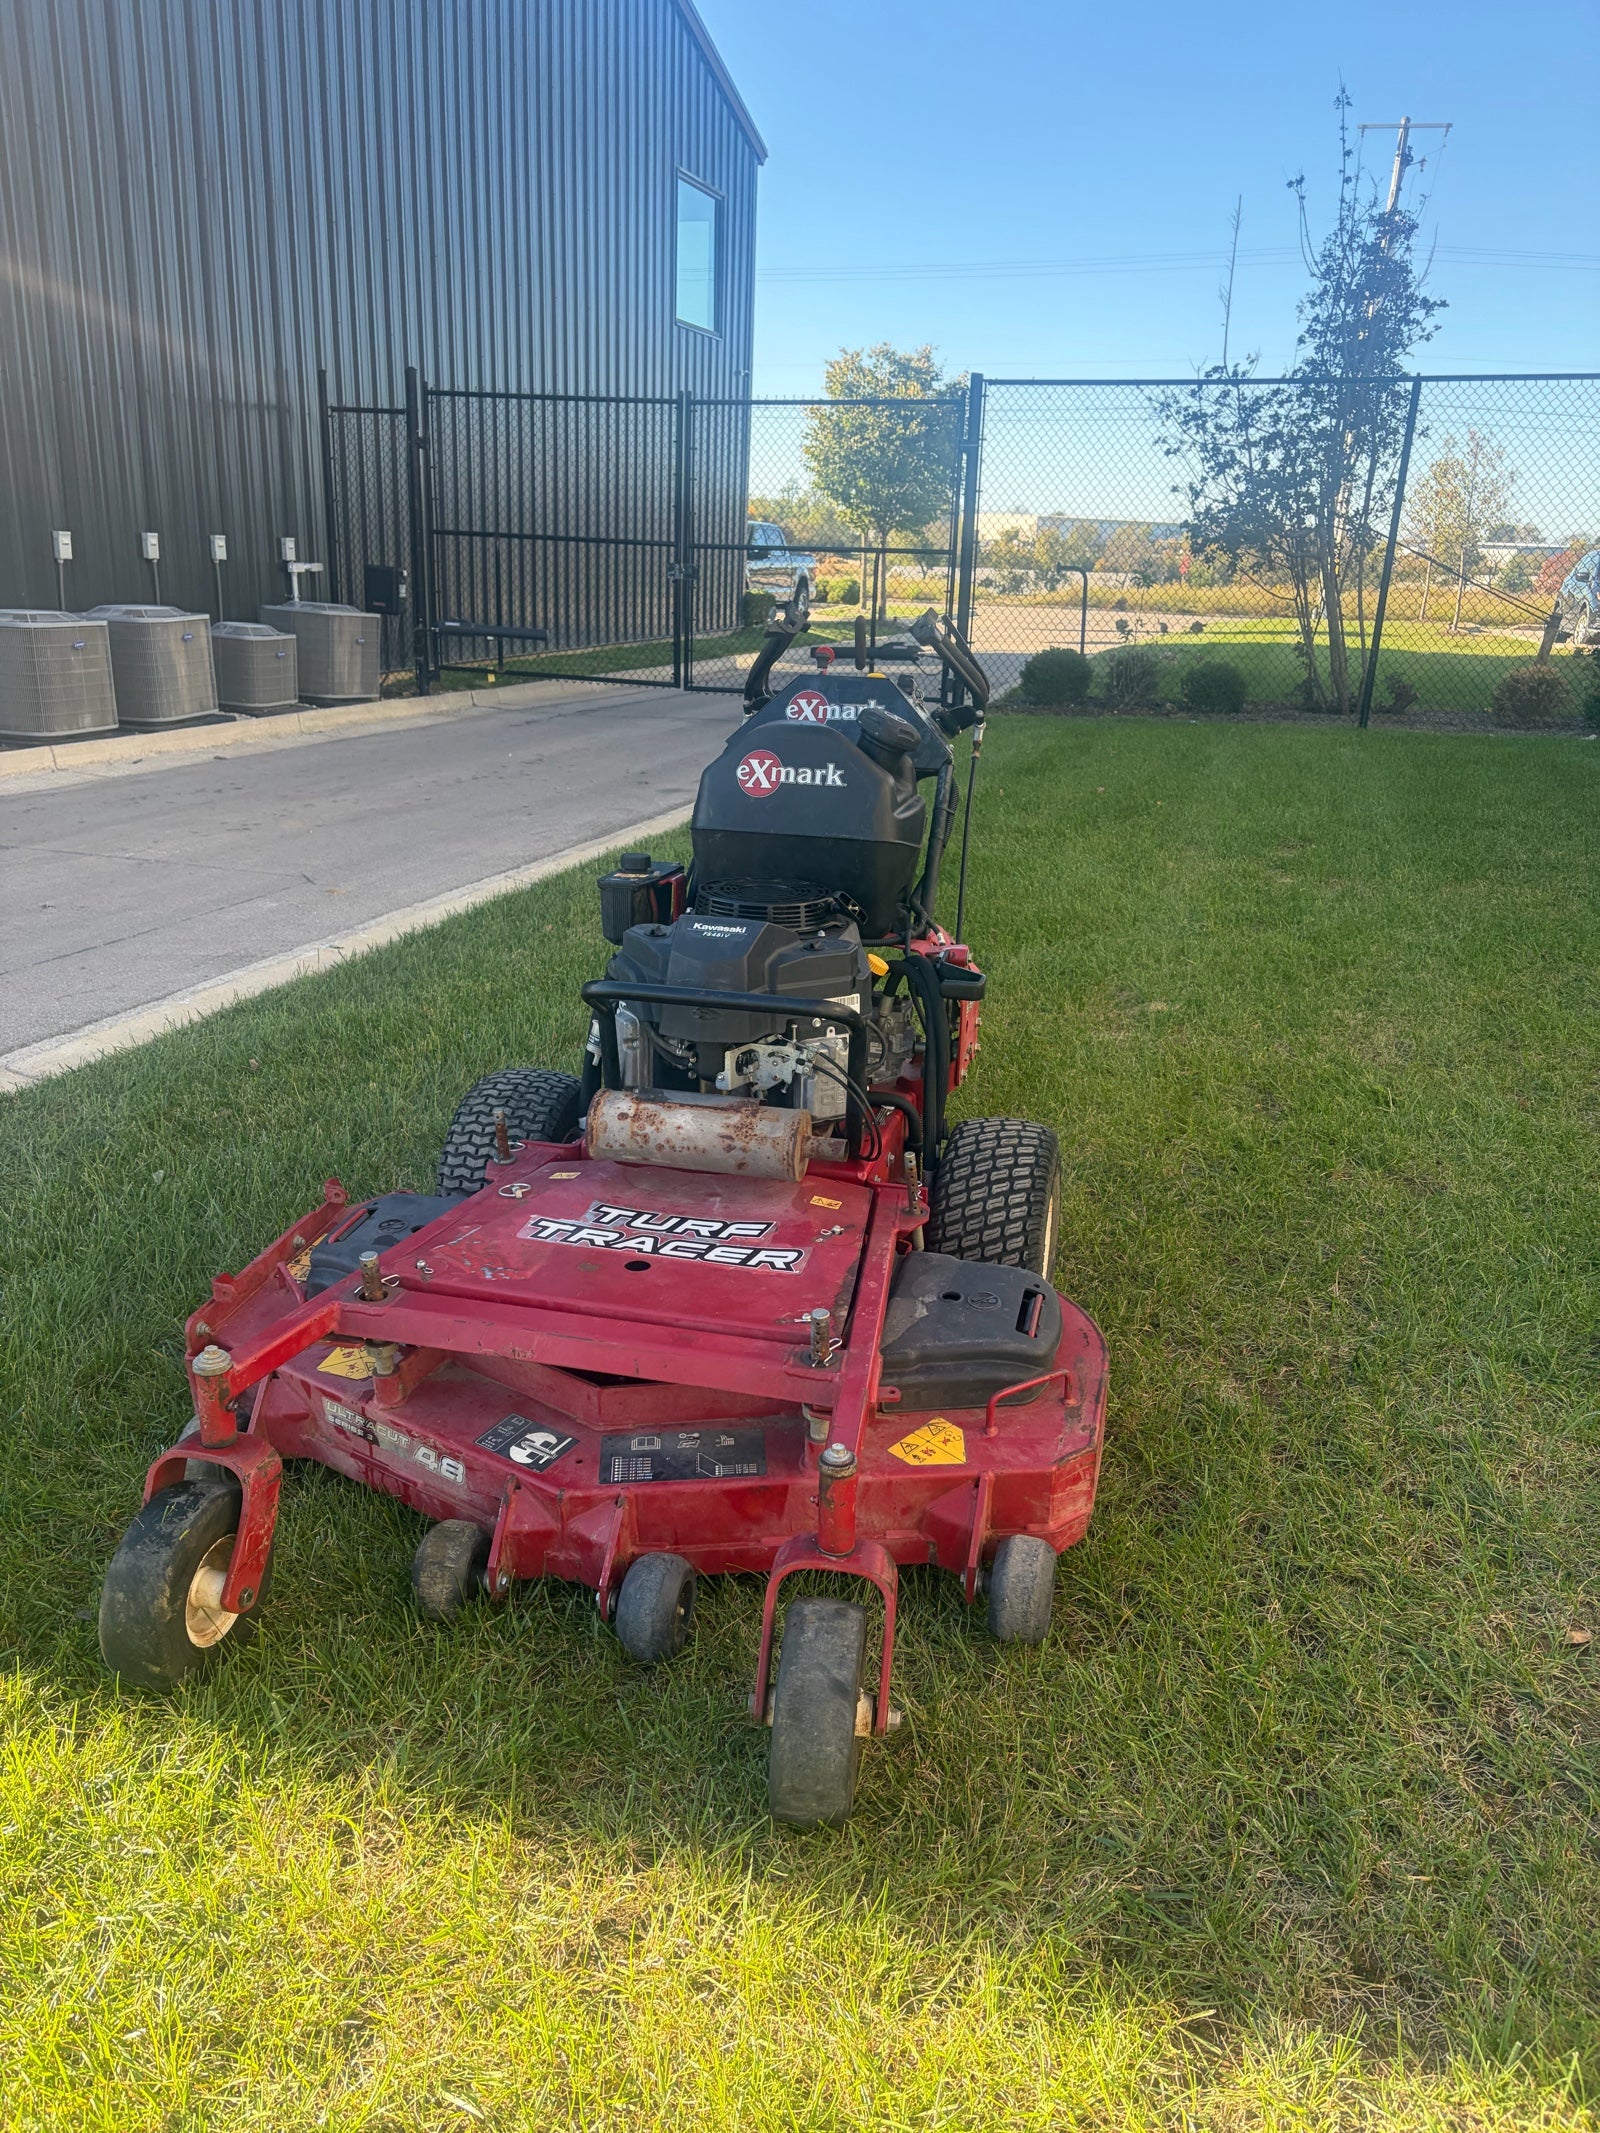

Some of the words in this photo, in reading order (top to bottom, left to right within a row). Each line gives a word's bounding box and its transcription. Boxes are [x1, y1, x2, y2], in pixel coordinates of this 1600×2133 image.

[693, 922, 747, 933] Kawasaki
[591, 1204, 776, 1239] TURF
[530, 1218, 804, 1272] TRACER
[326, 1400, 410, 1448] ULTRACUT
[327, 1415, 364, 1436] SERIES
[413, 1446, 465, 1484] 48
